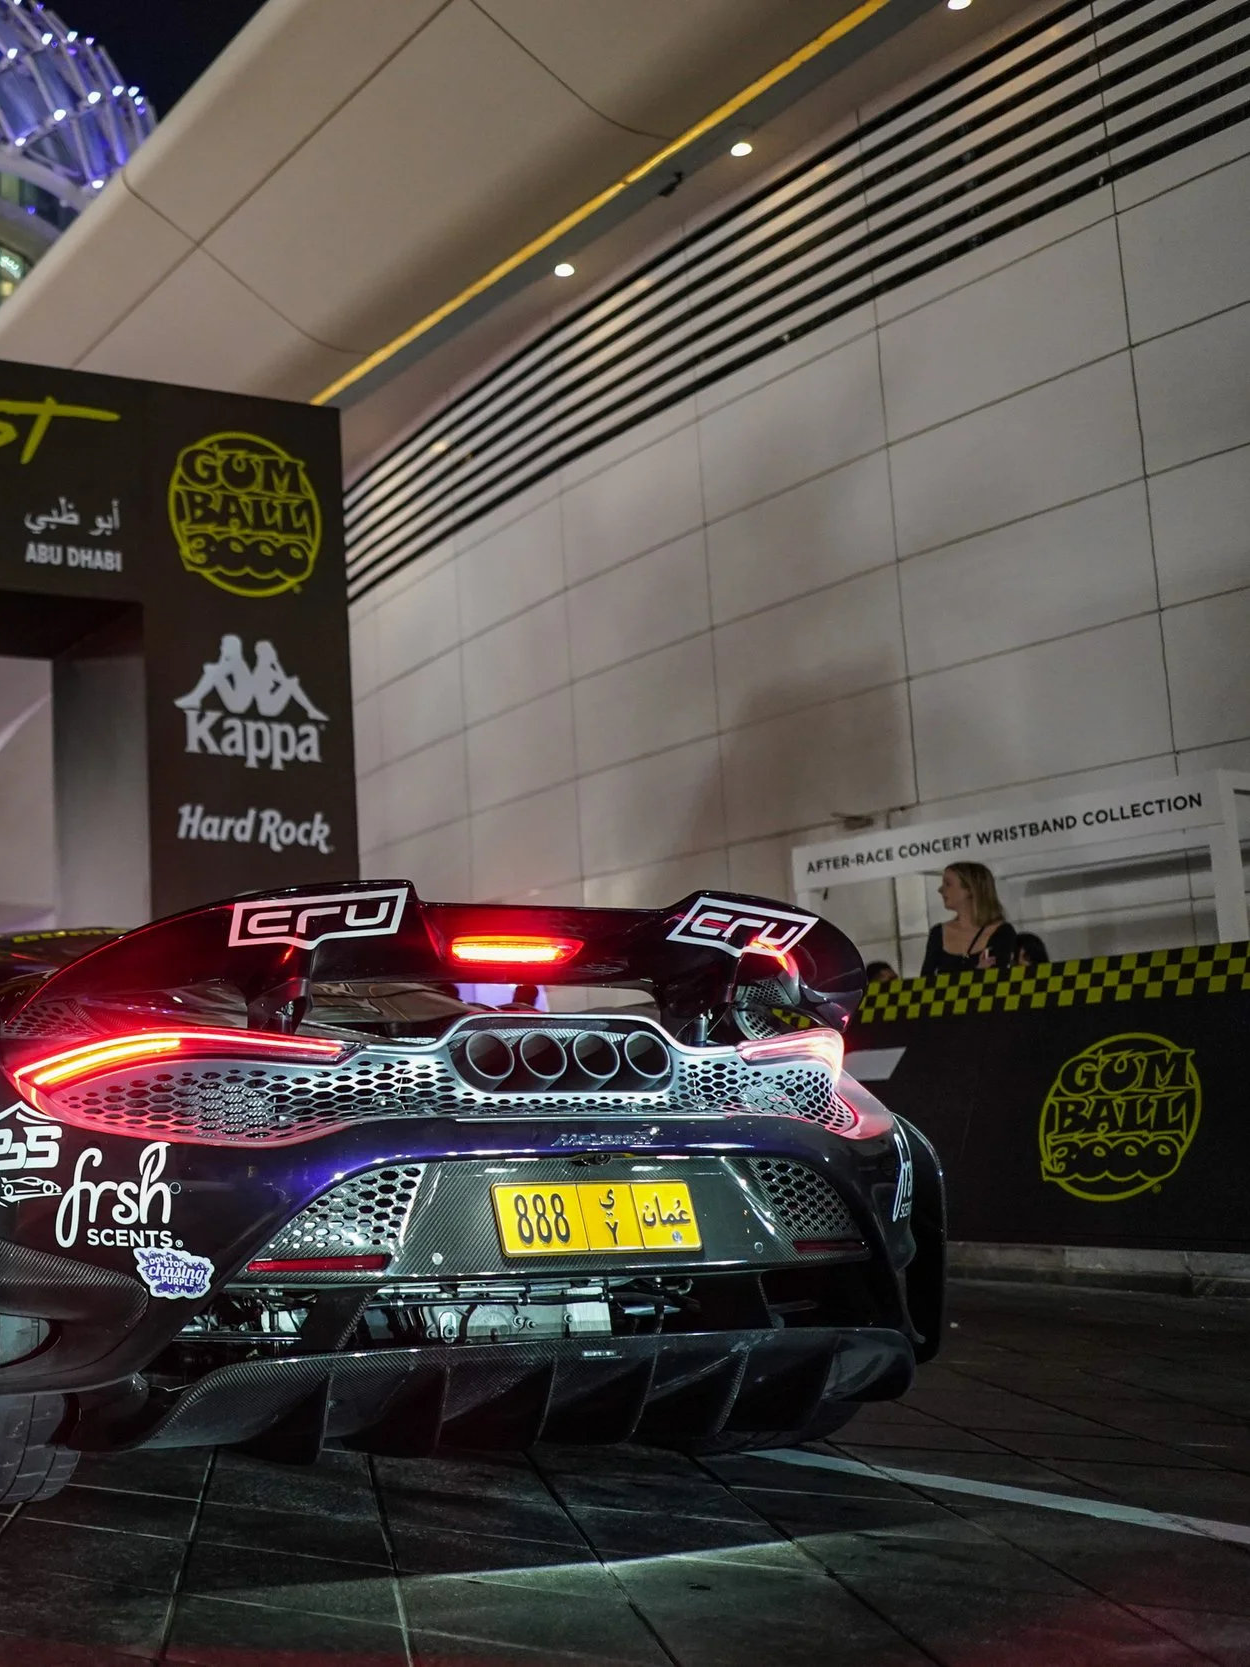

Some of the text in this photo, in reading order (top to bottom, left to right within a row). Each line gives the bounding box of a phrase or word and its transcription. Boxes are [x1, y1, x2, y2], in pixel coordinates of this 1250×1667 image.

[23, 496, 120, 536] أبو ظبي
[175, 487, 313, 543] BALL
[25, 541, 123, 572] ABU DHABI
[185, 709, 322, 771] Kappa
[177, 803, 331, 854] Hard Rock
[806, 793, 1203, 875] AFTER-RACE CONCERT WRISTBAND COLLECTION
[1050, 1092, 1188, 1138] BALL
[55, 1141, 172, 1248] frsh
[86, 1229, 173, 1248] SCENTS
[513, 1193, 571, 1246] 888
[148, 1263, 205, 1284] chasing
[161, 1276, 195, 1287] PURPLE
[164, 1260, 185, 1268] STOP
